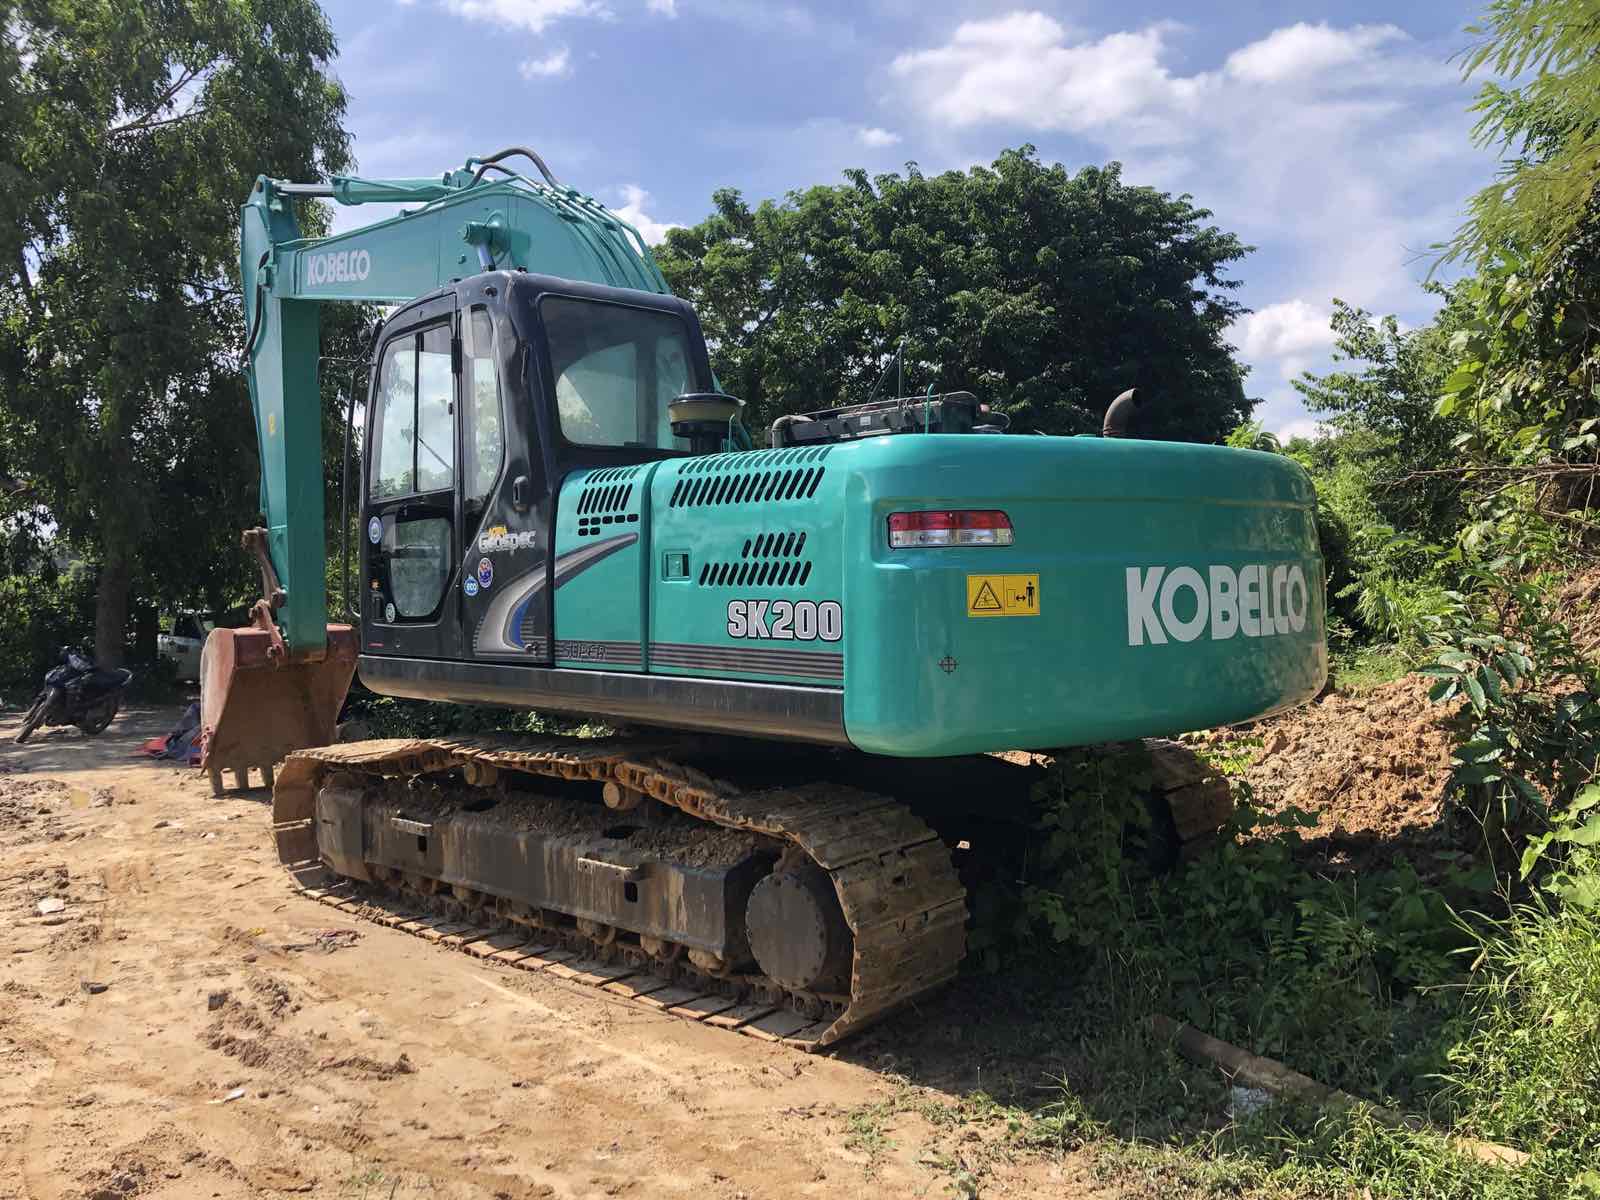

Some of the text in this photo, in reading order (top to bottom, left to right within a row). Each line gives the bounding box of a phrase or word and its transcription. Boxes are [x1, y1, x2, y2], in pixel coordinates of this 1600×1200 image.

[307, 249, 370, 286] KOBELCO
[727, 600, 843, 641] SK200
[1126, 565, 1307, 646] KOBELCO
